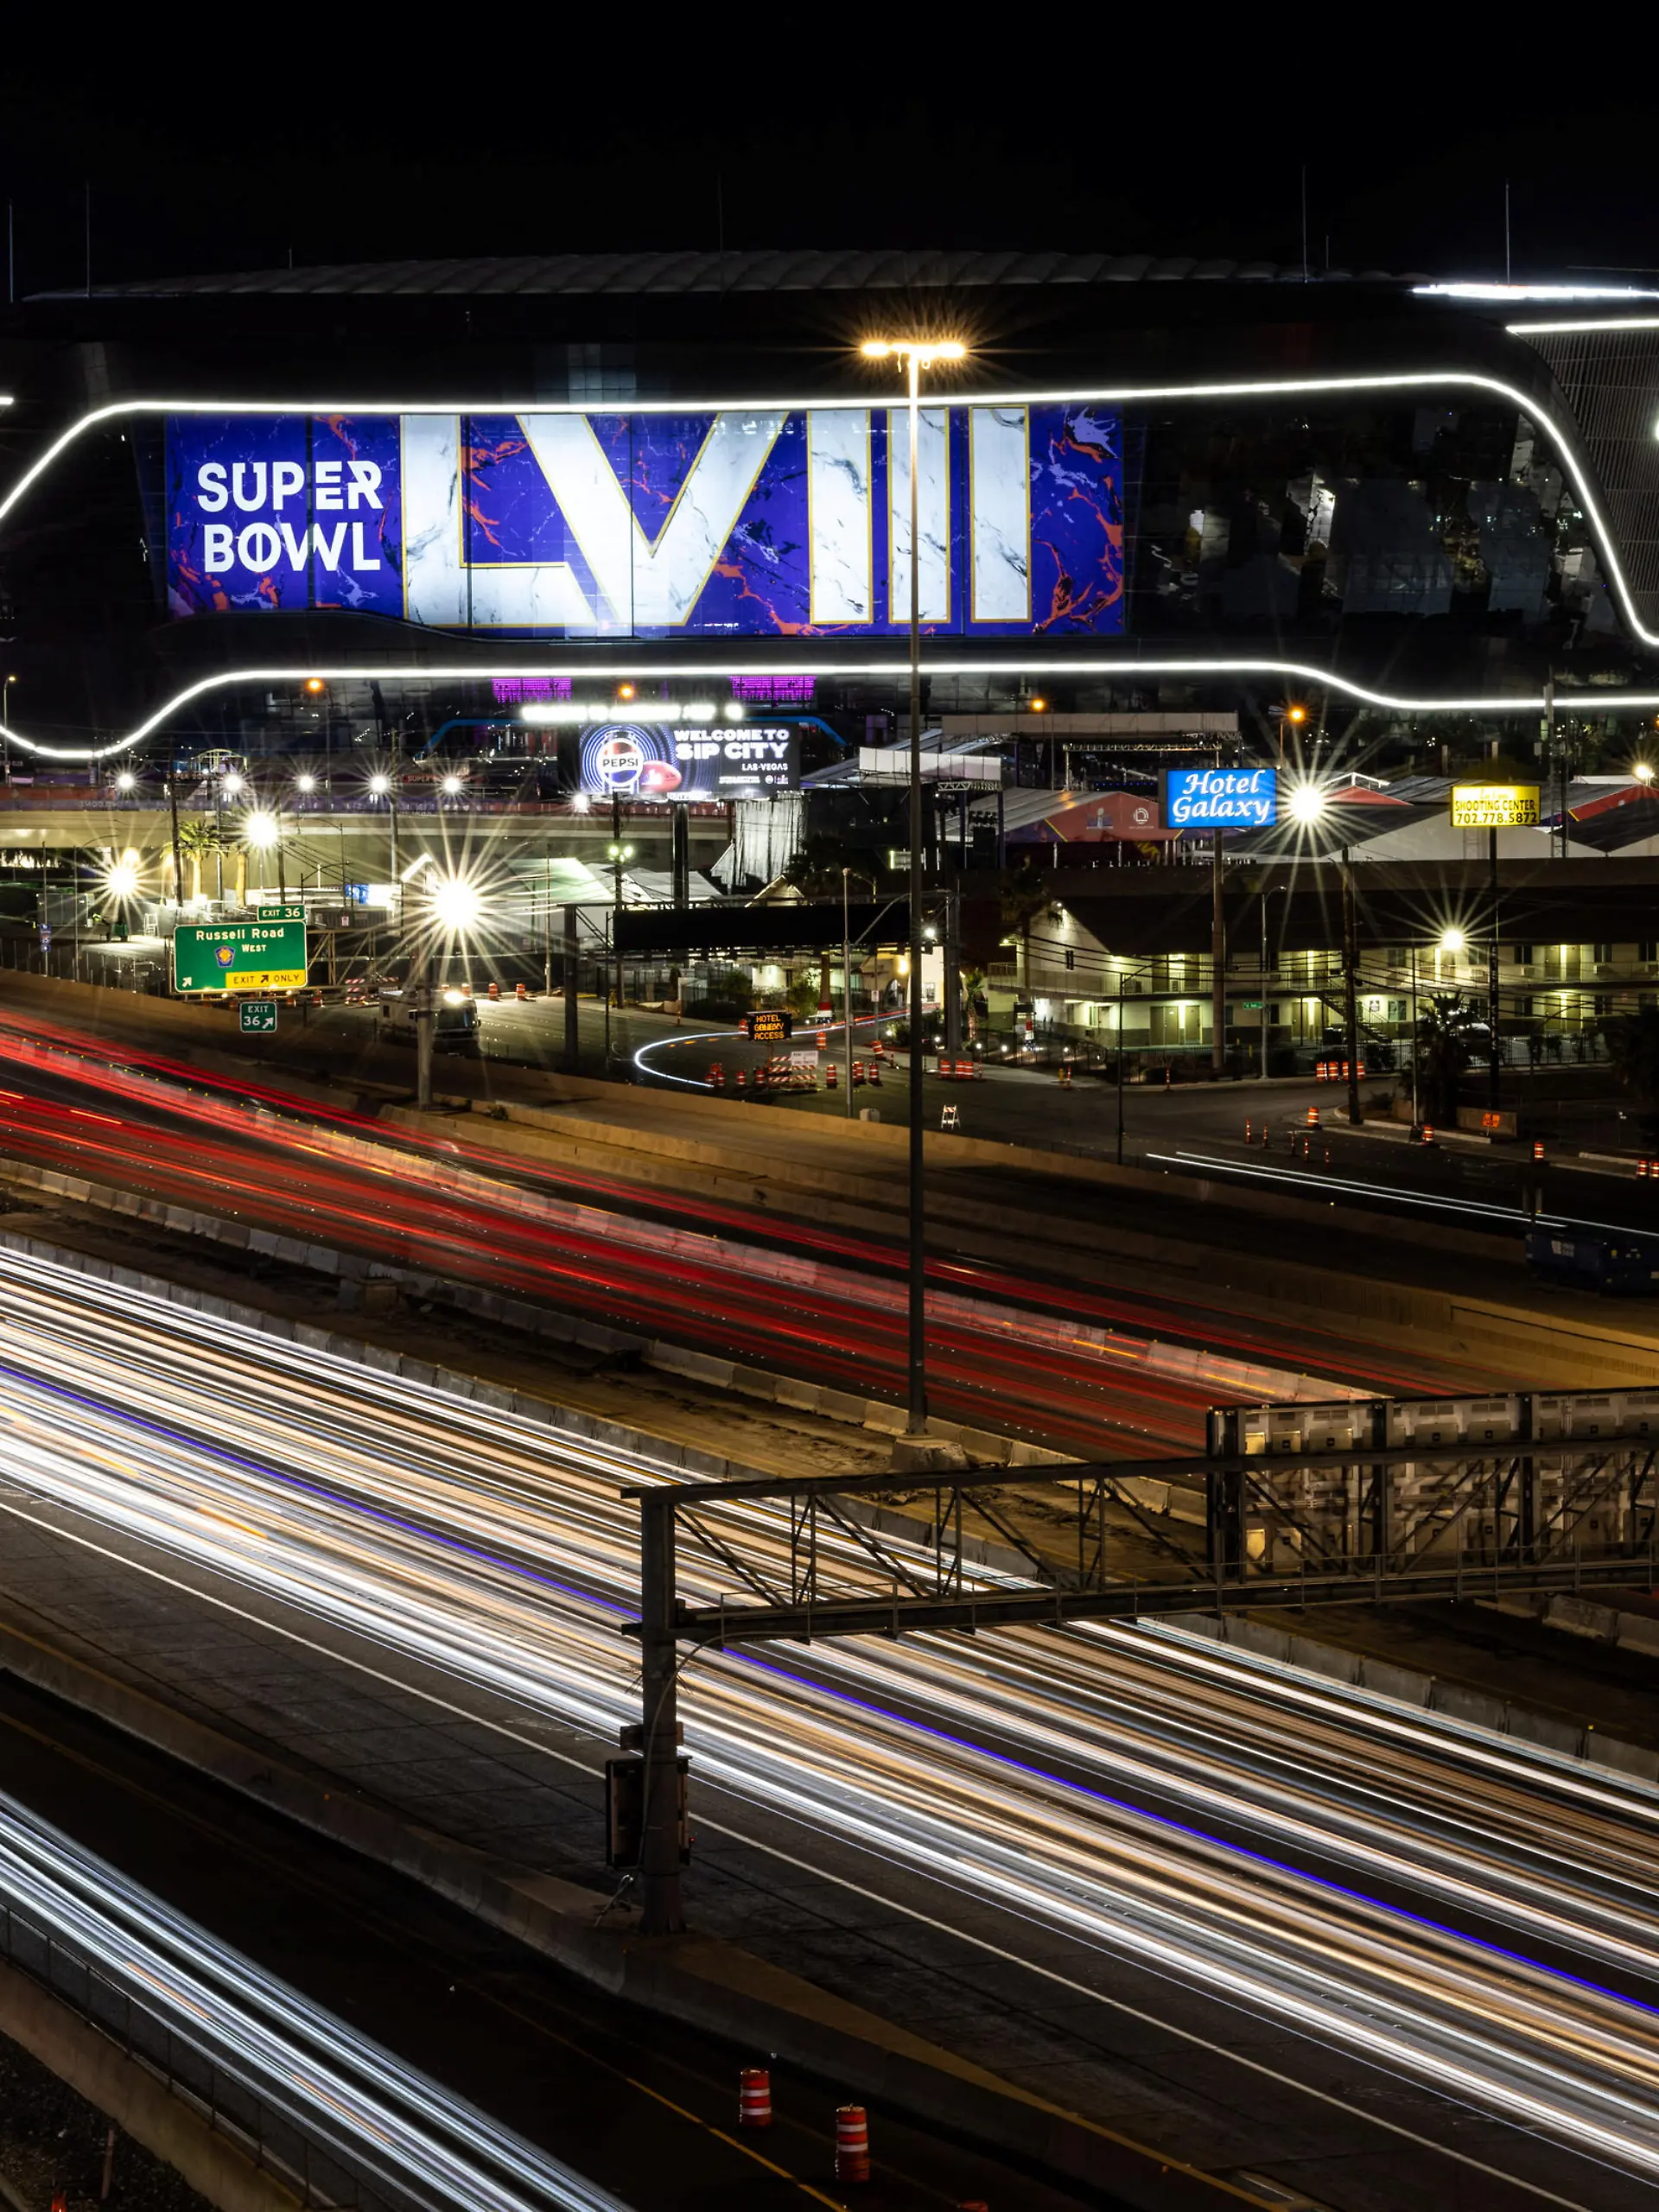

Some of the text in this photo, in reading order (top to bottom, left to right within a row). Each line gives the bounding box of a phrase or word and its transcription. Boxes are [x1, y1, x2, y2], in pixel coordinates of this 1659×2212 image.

[197, 460, 384, 513] SUPER
[400, 406, 1033, 628] LVIII
[204, 520, 380, 573] BOWL
[674, 729, 789, 741] WELCOME TO
[675, 742, 789, 760] SIP CITY
[602, 758, 639, 767] PEPSI
[1182, 770, 1265, 795] Hotel
[1171, 793, 1272, 823] Galaxy
[1455, 799, 1535, 811] SHOOTING CENTER
[1457, 812, 1537, 823] 702.778.5872
[262, 907, 301, 918] EXIT 36
[195, 927, 284, 941] Russell Road
[241, 944, 267, 953] WEST
[233, 974, 300, 984] EXIT ONLY
[247, 1005, 269, 1014] EXIT
[243, 1015, 261, 1027] 36
[756, 1014, 781, 1023] HOTEL
[753, 1031, 785, 1040] ACCESS
